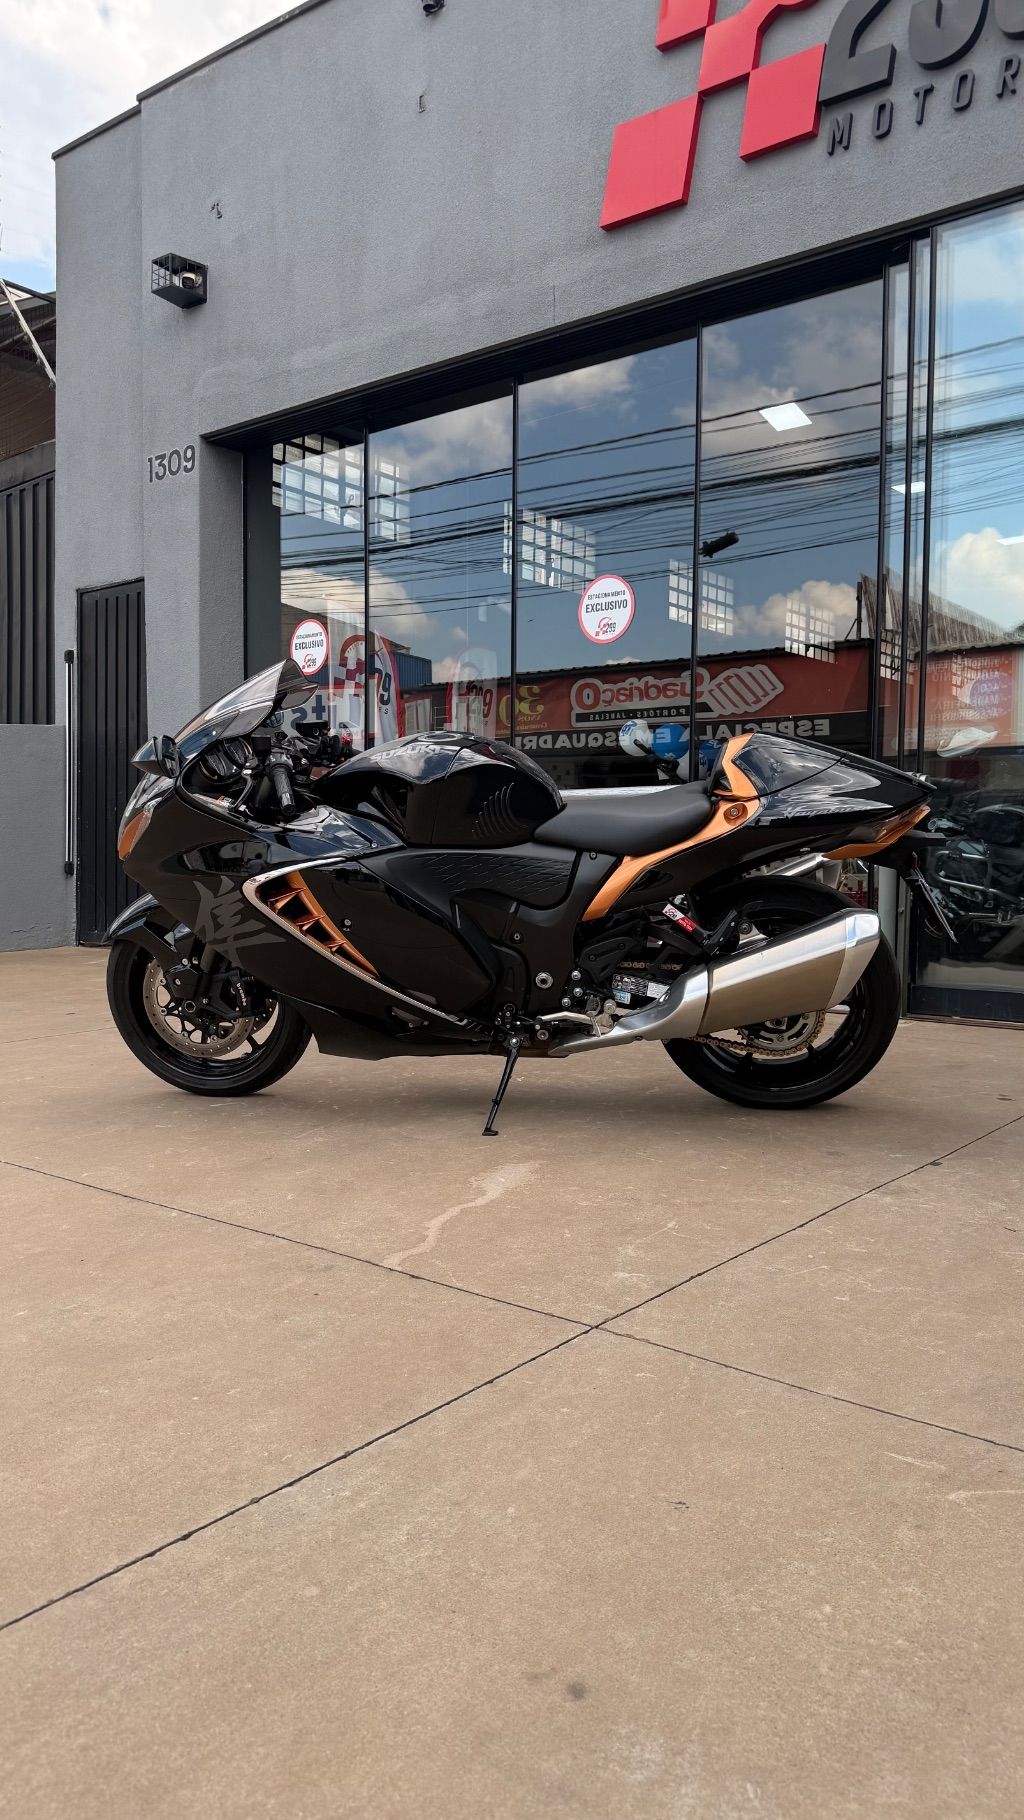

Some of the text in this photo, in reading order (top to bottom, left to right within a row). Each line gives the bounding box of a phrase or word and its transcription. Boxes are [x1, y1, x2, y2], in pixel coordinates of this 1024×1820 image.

[148, 445, 196, 483] 1309
[585, 599, 628, 613] EXCLUSIVO
[294, 639, 324, 650] EXCLUSIVO
